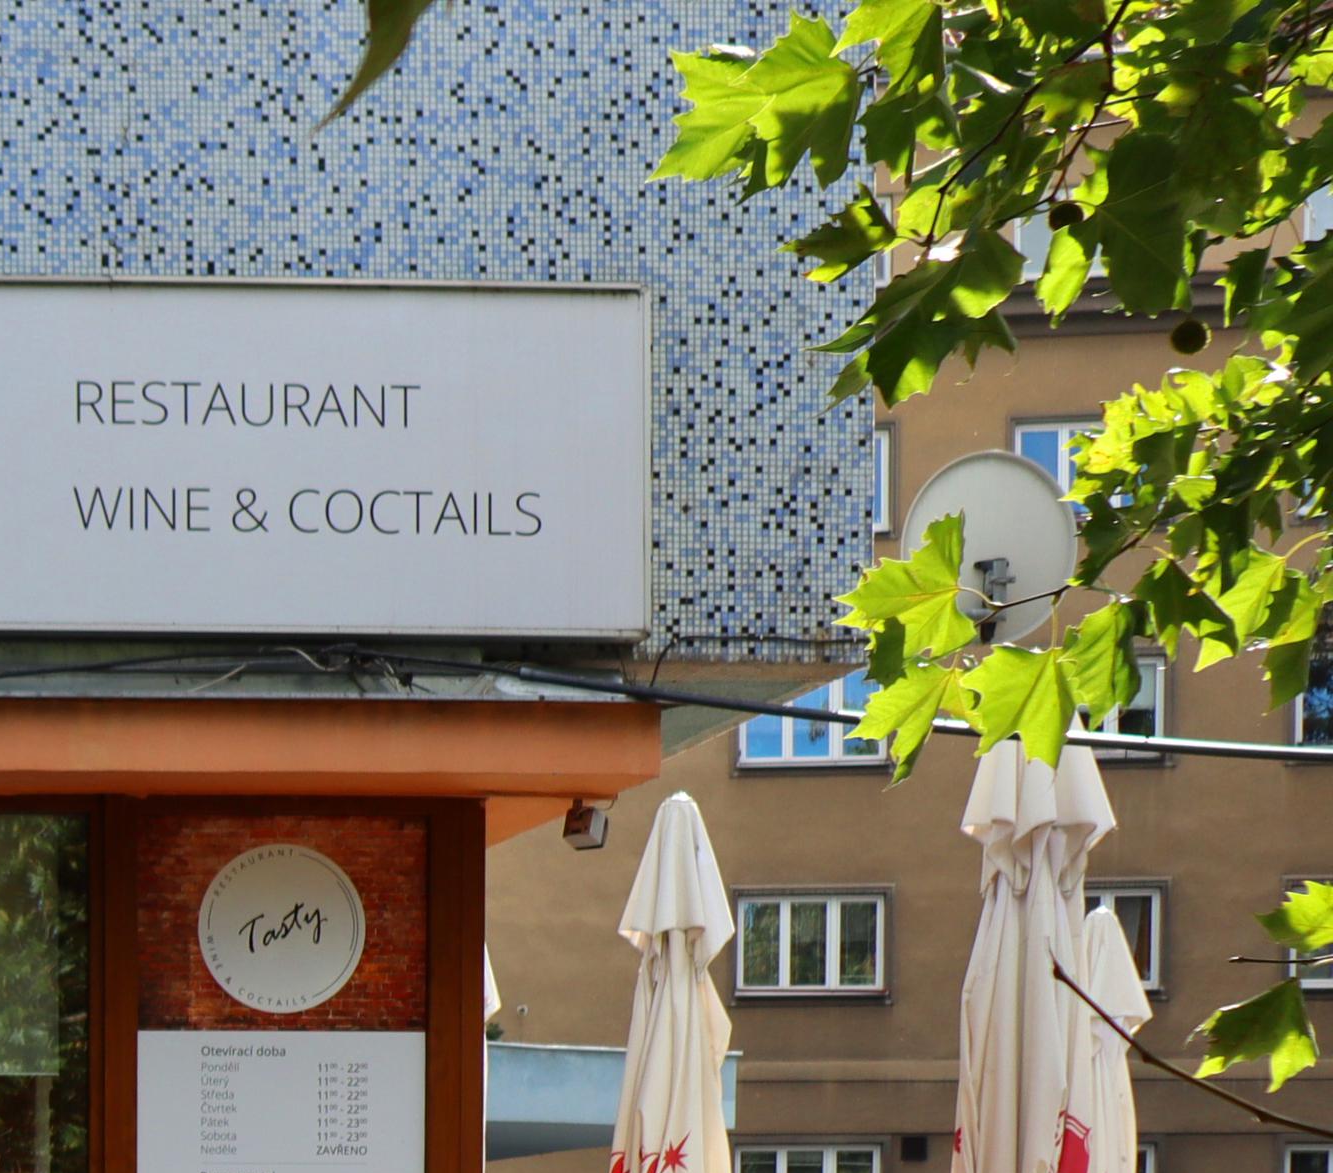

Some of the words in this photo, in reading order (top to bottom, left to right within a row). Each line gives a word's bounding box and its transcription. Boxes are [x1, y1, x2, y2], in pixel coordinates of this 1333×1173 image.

[77, 381, 420, 428] RESTAURANT
[74, 487, 210, 531] WINE
[232, 488, 268, 532] &
[289, 489, 541, 536] COCTAILS
[213, 849, 294, 897] RESTAURANT
[239, 902, 327, 953] Tasty
[238, 987, 307, 1007] COCTAILS
[201, 1046, 253, 1057] Otevírací
[256, 1046, 286, 1057] doba
[201, 1090, 235, 1100] Středa
[201, 1103, 237, 1113] Čtvrtek
[201, 1117, 229, 1127] Pátek
[201, 1132, 237, 1141] Sobota
[201, 1145, 237, 1155] Neděle
[316, 1144, 368, 1156] ZAVŘENO
